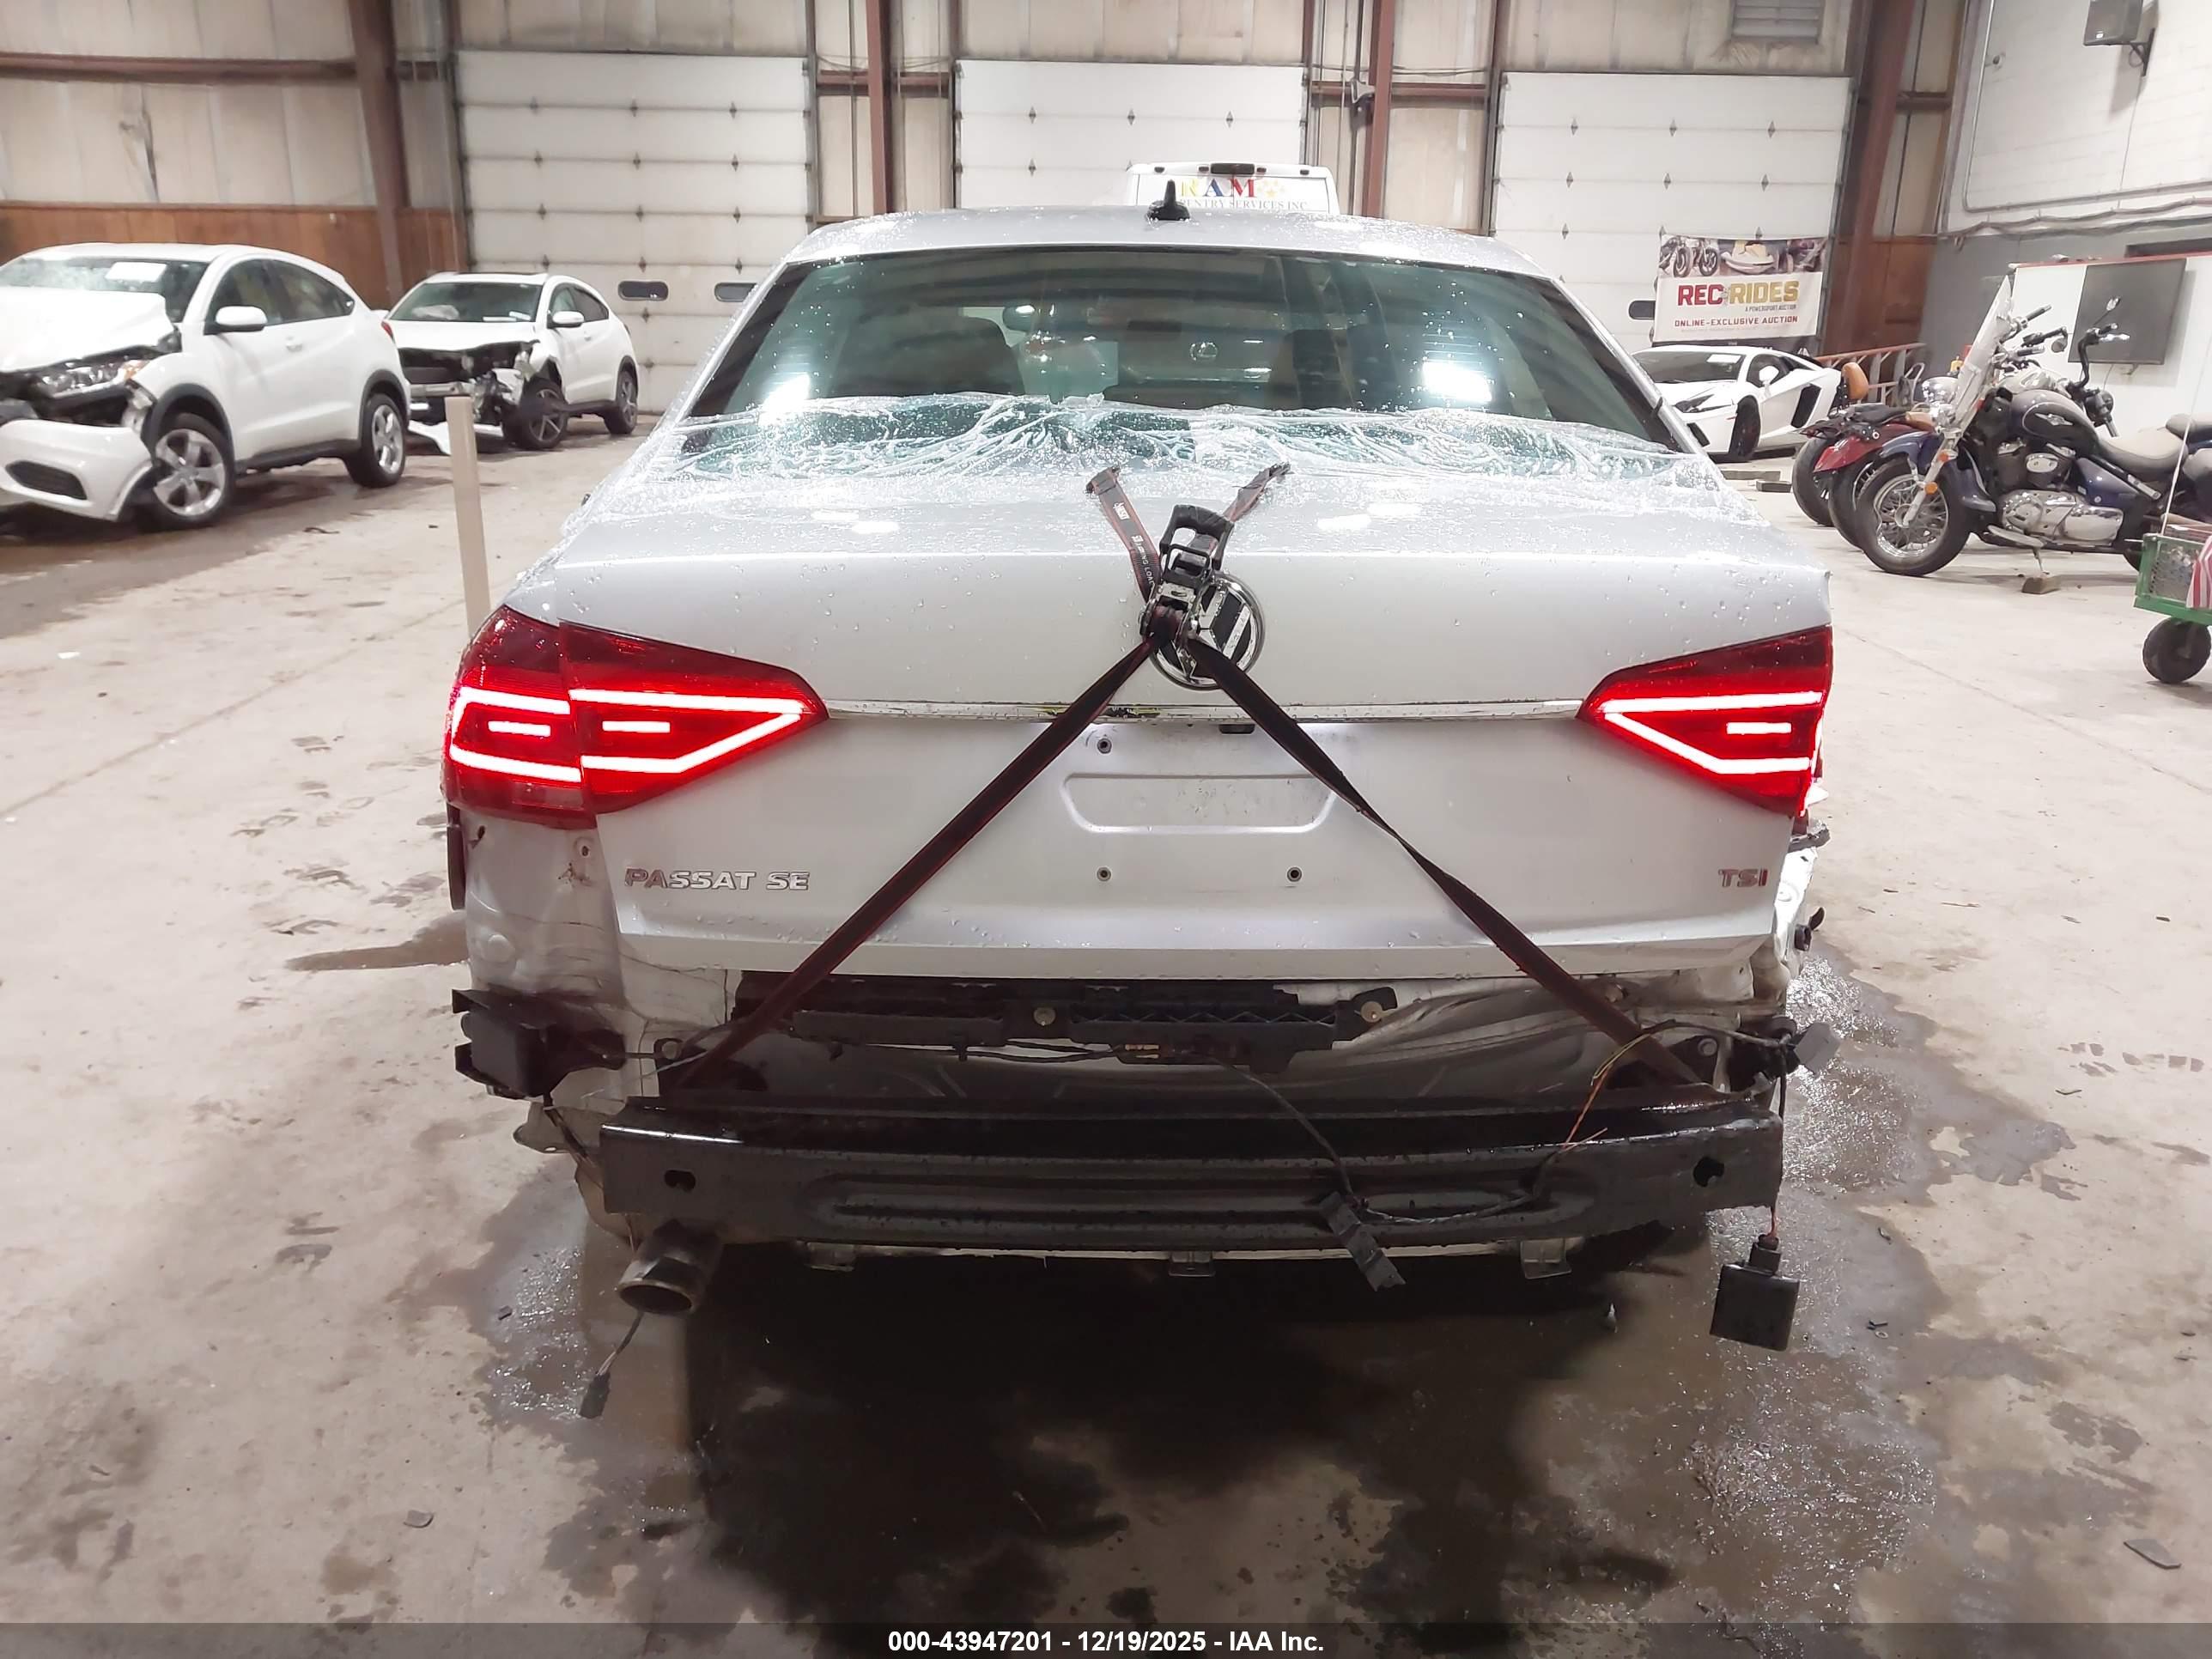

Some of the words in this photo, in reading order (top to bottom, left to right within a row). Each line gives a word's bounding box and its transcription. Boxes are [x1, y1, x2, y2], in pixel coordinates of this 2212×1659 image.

[1229, 199, 1285, 210] SERVICES
[1678, 283, 1724, 306] REC
[1729, 281, 1800, 304] RIDES
[1674, 317, 1759, 327] ONLINE-EXCLUSIVE
[1762, 315, 1798, 325] AUCTION
[624, 867, 757, 890] PASSAT
[766, 871, 811, 890] SE
[1717, 868, 1768, 888] TSI
